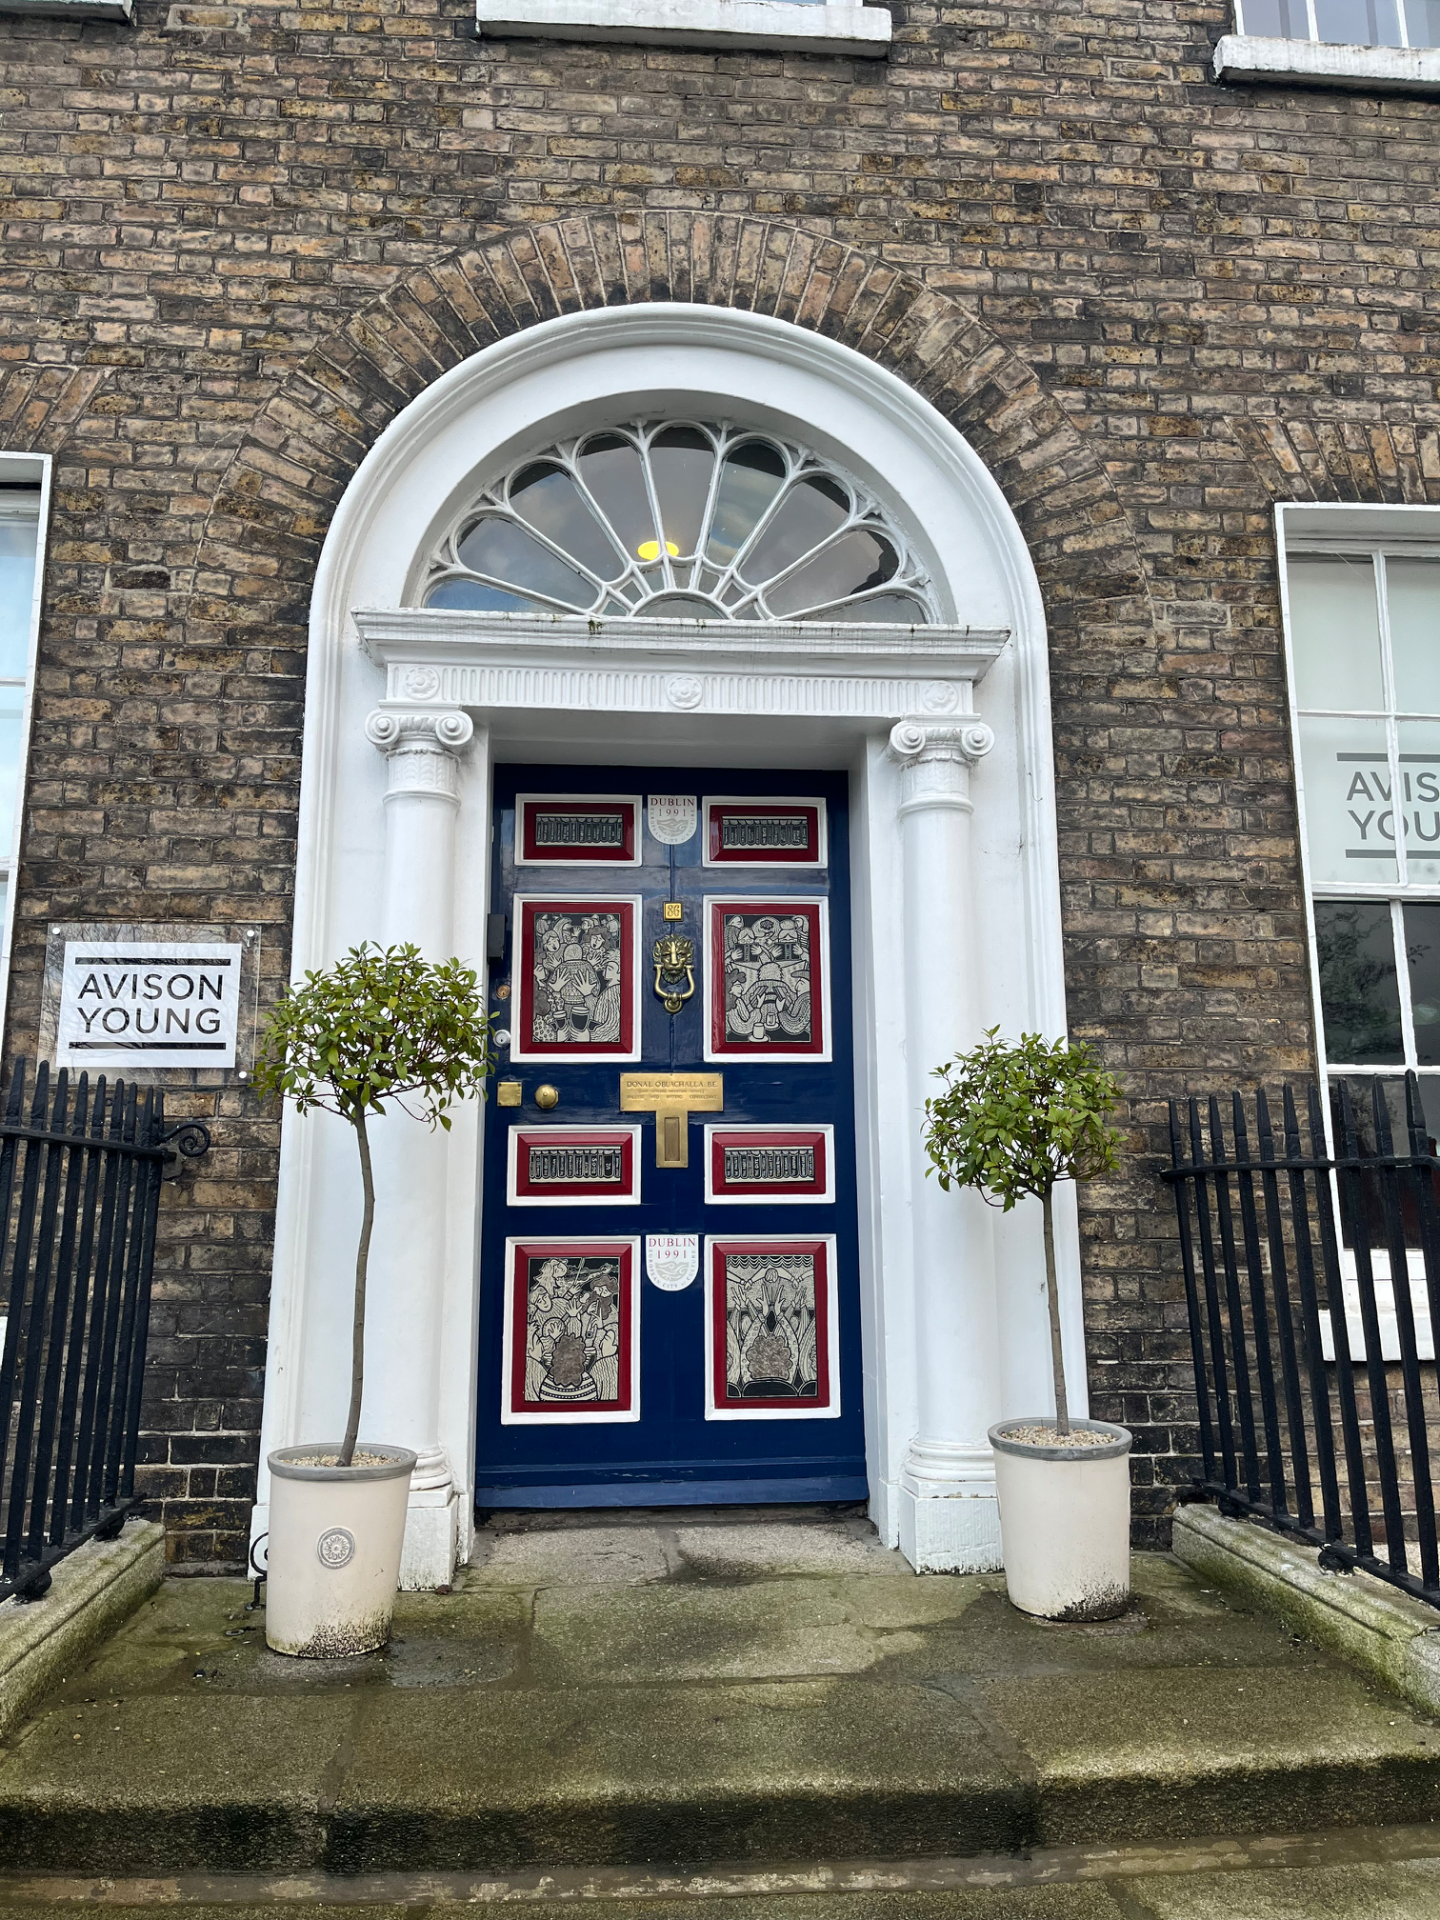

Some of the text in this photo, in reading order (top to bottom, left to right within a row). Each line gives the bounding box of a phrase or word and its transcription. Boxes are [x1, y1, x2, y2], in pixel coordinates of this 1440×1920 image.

[650, 797, 695, 807] DUBLIN
[658, 808, 686, 817] 1991
[667, 904, 680, 917] 86
[77, 973, 223, 1001] AVISON
[77, 1007, 220, 1035] YOUNG
[626, 1080, 653, 1088] DONAL
[648, 1237, 696, 1247] DUBLIN
[657, 1249, 687, 1259] 1991
